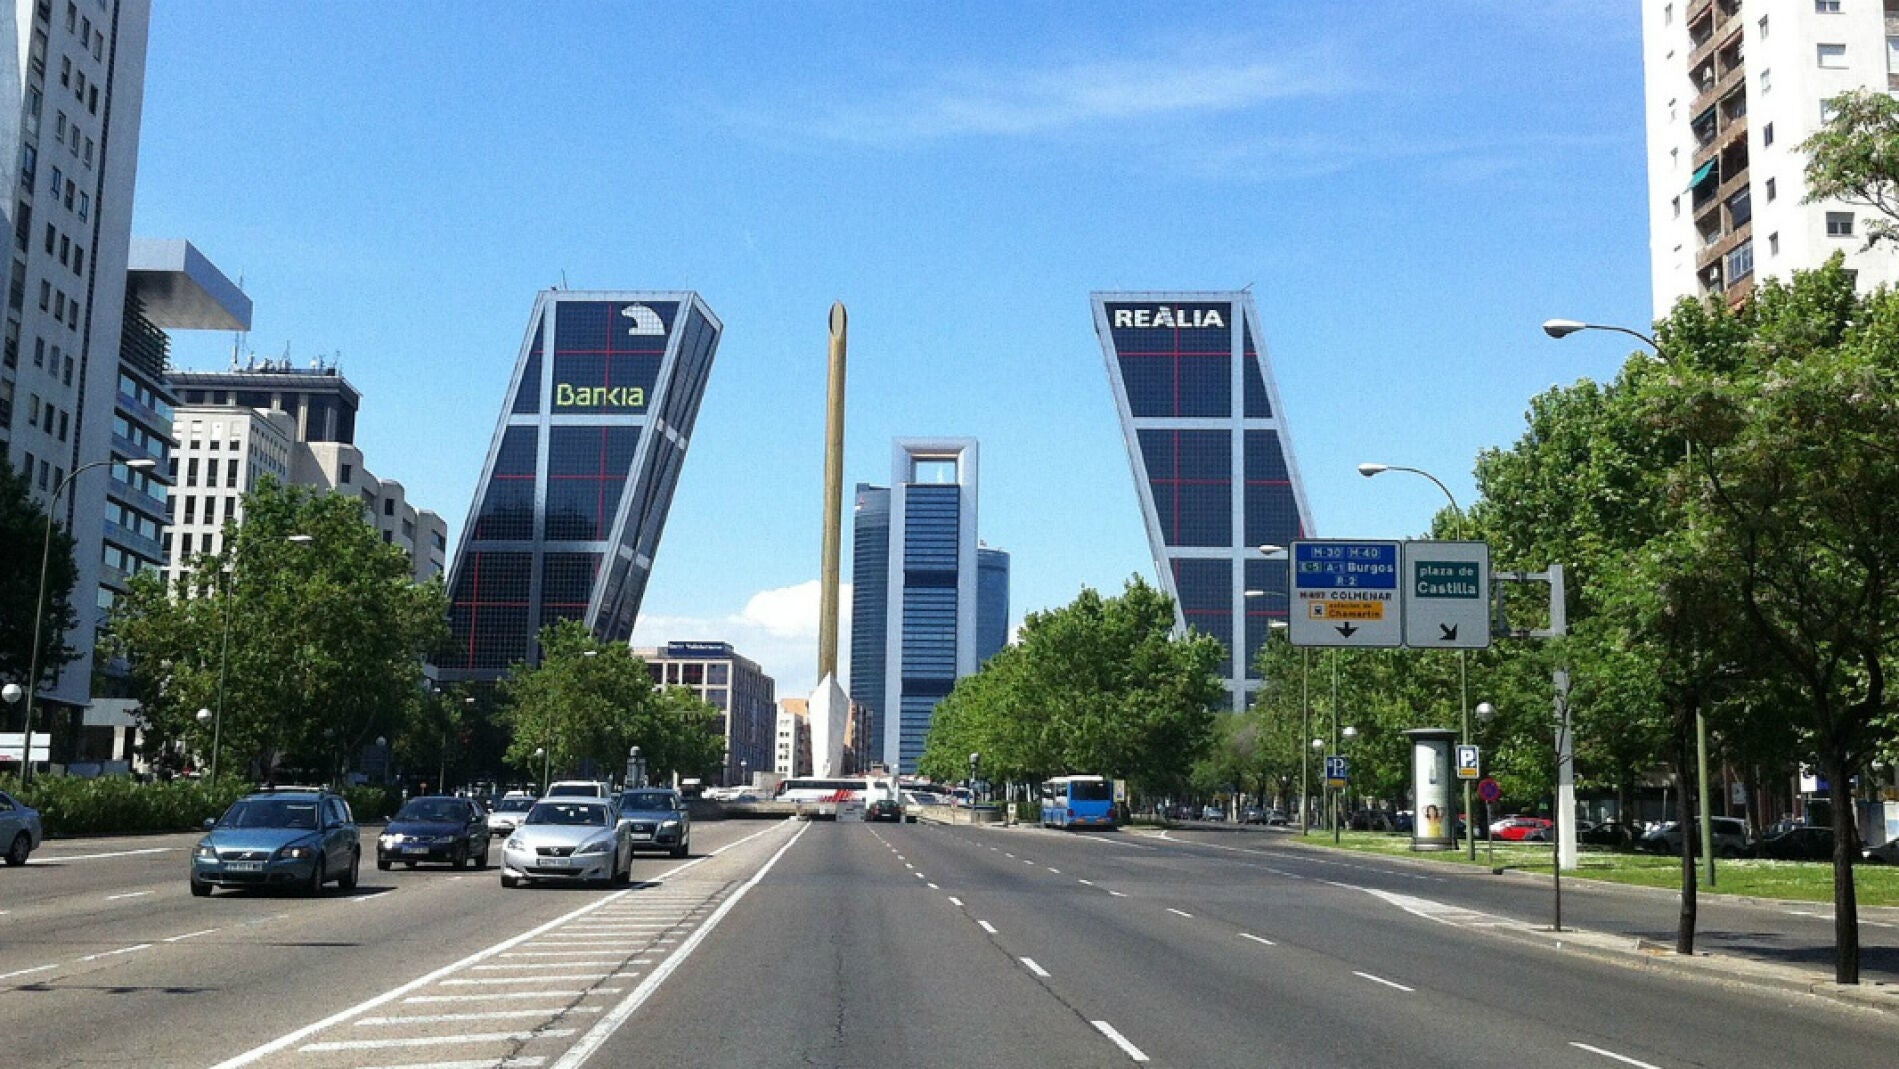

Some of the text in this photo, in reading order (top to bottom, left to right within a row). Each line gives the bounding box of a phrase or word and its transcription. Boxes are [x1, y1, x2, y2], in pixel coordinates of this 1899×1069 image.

[556, 382, 644, 407] Bankia
[1347, 561, 1394, 575] Burgos
[1419, 565, 1475, 577] plaza de
[1417, 580, 1477, 595] Castilla
[1330, 590, 1393, 601] COLMENAR
[1333, 758, 1344, 776] P
